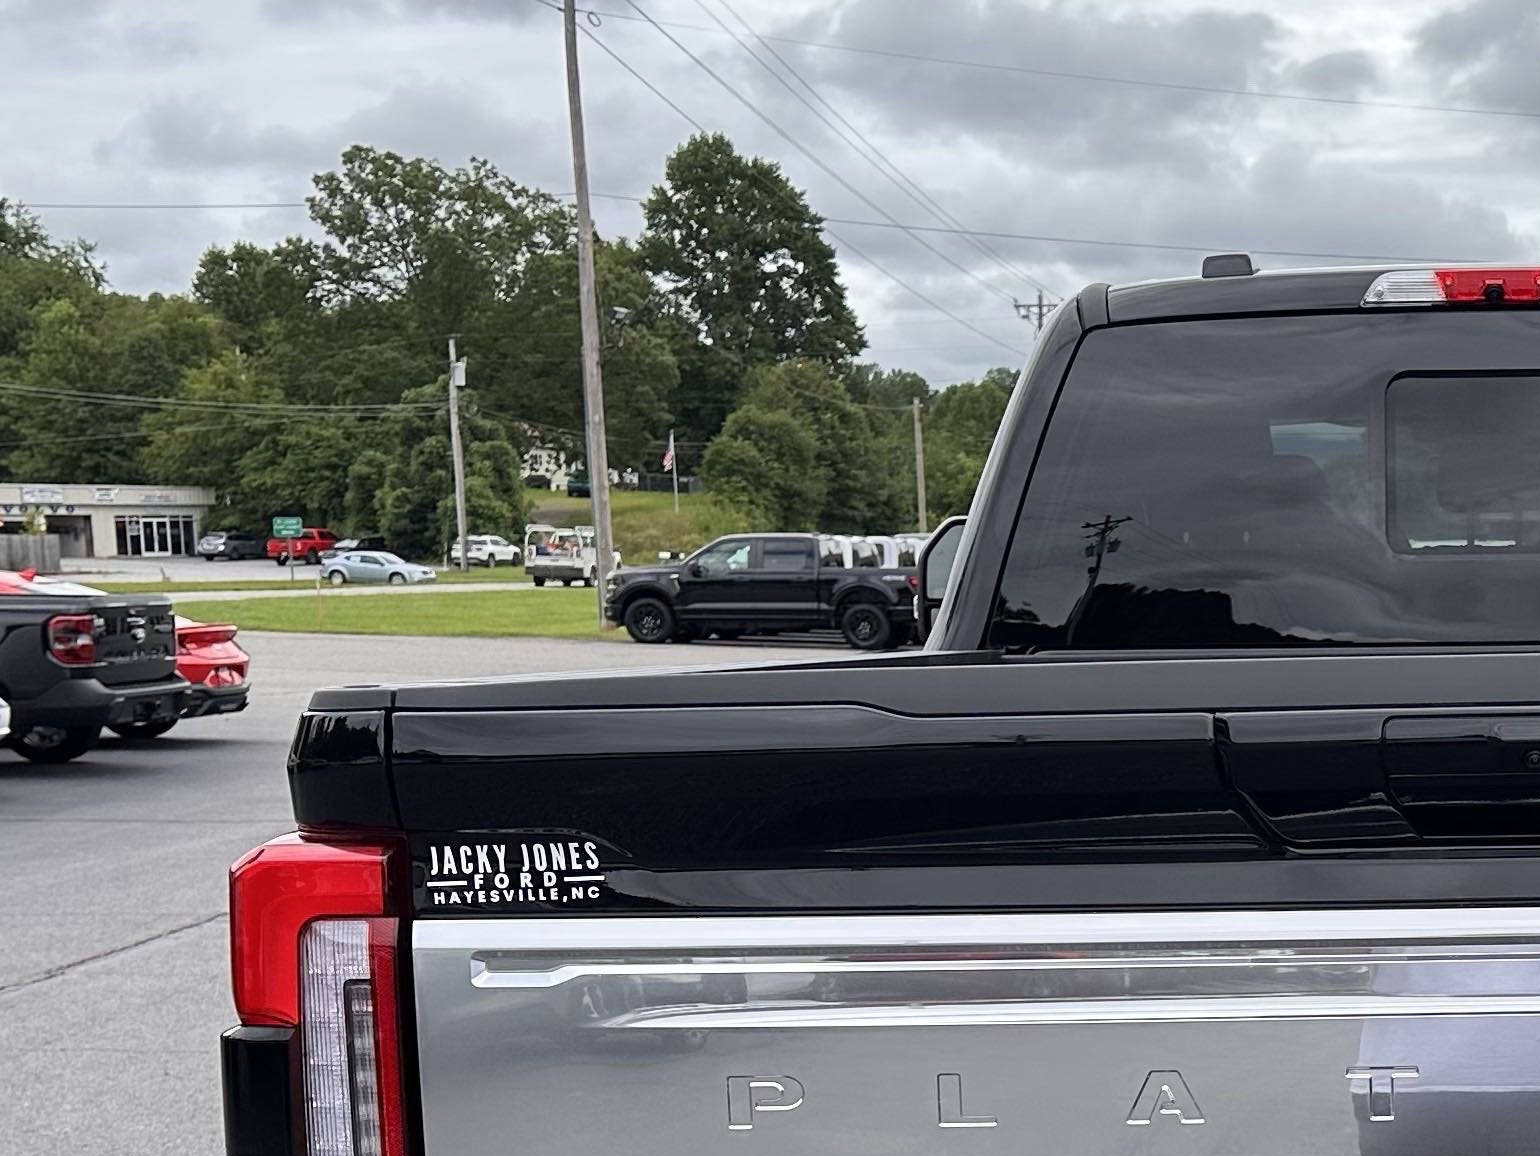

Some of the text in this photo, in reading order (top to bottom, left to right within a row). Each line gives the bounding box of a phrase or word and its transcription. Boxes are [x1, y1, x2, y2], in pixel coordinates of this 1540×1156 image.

[430, 841, 600, 875] JACKY JONES
[473, 871, 558, 890] FORD
